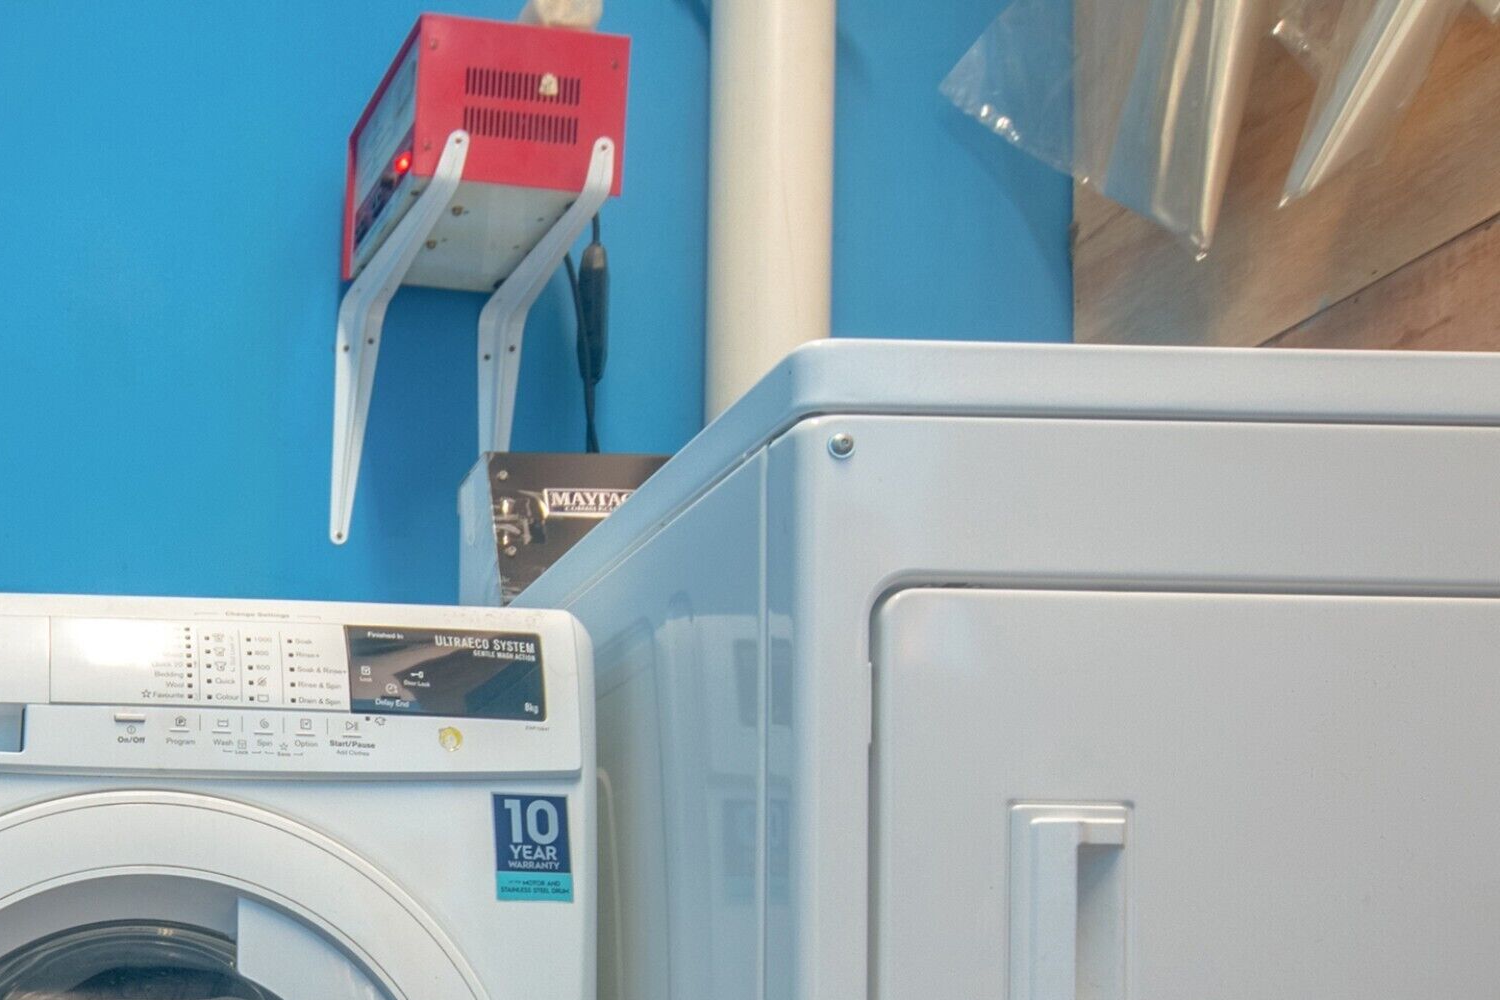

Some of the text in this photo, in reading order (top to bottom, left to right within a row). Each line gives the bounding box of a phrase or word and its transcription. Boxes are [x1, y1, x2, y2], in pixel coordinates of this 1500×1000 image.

[367, 631, 397, 639] Finished
[434, 635, 535, 654] ULTRAECO SYSTEM
[473, 649, 536, 662] GENTLE WASH ACTION
[154, 670, 184, 679] Bedding
[165, 680, 184, 688] Wool
[326, 682, 342, 690] Spin
[325, 698, 341, 706] Spin
[375, 698, 410, 708] Delay End
[165, 737, 196, 746] Program
[213, 738, 234, 746] Wash
[256, 739, 273, 748] Spin
[294, 739, 318, 748] Option
[329, 739, 376, 749] Start/Pause
[504, 798, 560, 846] 10
[509, 844, 558, 861] YEAR
[508, 860, 561, 870] WARRANTY
